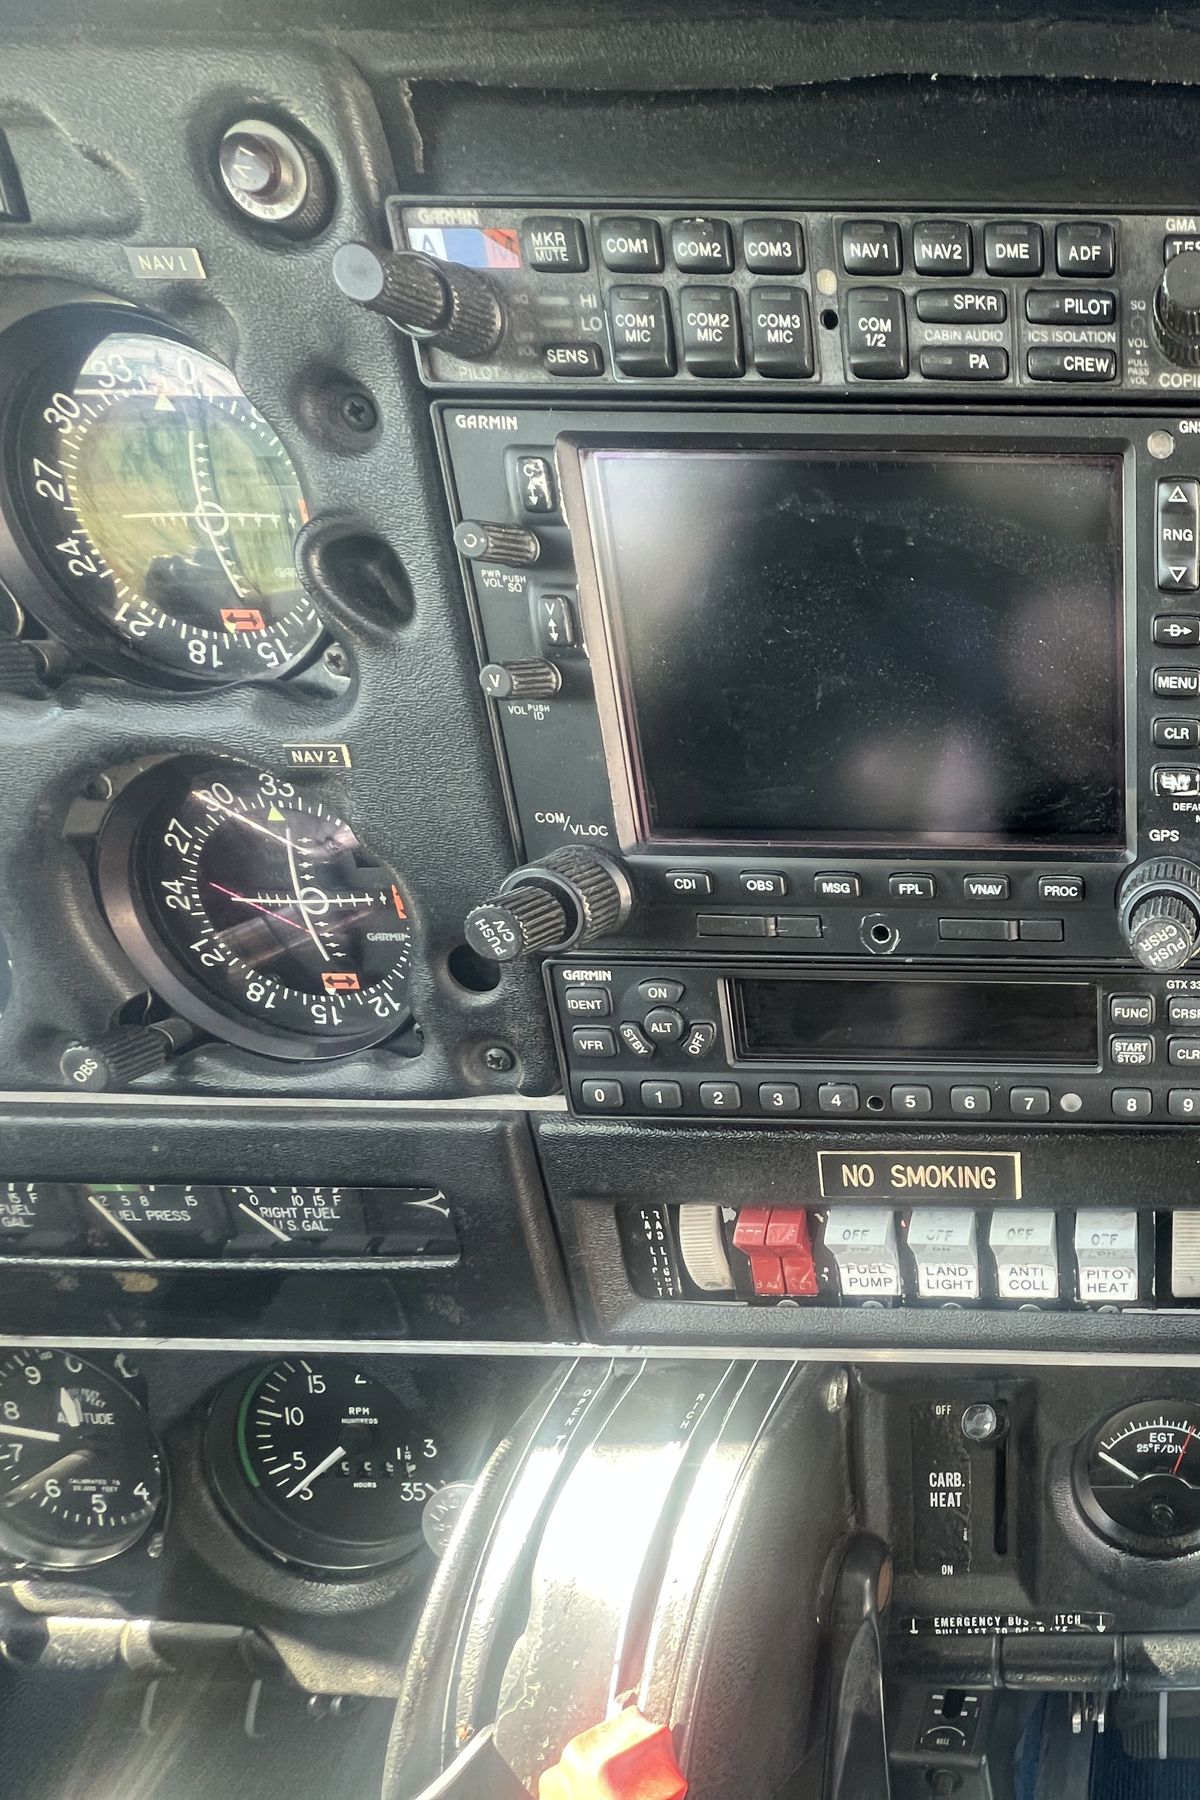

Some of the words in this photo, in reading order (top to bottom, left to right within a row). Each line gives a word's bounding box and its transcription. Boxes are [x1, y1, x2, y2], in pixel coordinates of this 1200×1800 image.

[531, 232, 566, 247] MKR
[606, 239, 648, 254] COM1
[678, 242, 721, 257] COM2
[748, 242, 791, 257] COM3
[850, 244, 888, 258] NAV1
[922, 245, 962, 259] NAV2
[996, 244, 1029, 258] DME
[1069, 246, 1101, 261] ADF
[954, 296, 997, 311] SPKR
[1065, 299, 1110, 315] PILOT
[615, 314, 655, 328] COM1
[687, 314, 729, 328] COM2
[758, 314, 800, 328] COM3
[859, 318, 891, 332] COM
[625, 330, 650, 343] MIC
[697, 329, 723, 342] MIC
[767, 330, 793, 343] MIC
[865, 333, 886, 347] 1/2
[925, 329, 966, 342] CABIN
[969, 329, 1003, 342] AUDIO
[547, 350, 588, 363] SENS
[969, 355, 988, 369] PA
[1064, 357, 1109, 371] CREW
[44, 392, 80, 434] 30
[455, 415, 517, 430] GARMIN
[35, 458, 63, 501] 27
[1163, 529, 1193, 541] RNG
[56, 539, 96, 577] 24
[483, 578, 503, 589] VOL
[508, 582, 522, 593] SQ
[115, 606, 154, 637] 21
[1158, 676, 1197, 688] MENU
[508, 705, 527, 715] VOL
[528, 704, 550, 713] PUSH
[1164, 728, 1189, 739] CLR
[164, 818, 192, 854] 27
[1150, 830, 1180, 841] GPS
[747, 880, 773, 891] OBS
[822, 882, 850, 894] MSG
[899, 884, 923, 895] FPL
[970, 884, 1001, 895] VNAV
[1044, 885, 1078, 897] PROC
[162, 879, 190, 910] 24
[475, 917, 506, 955] PUSH
[1139, 924, 1177, 952] CRSR
[190, 938, 225, 967] 21
[563, 970, 611, 981] GARMIN
[246, 982, 275, 1008] 18
[648, 988, 667, 998] ON
[568, 1000, 602, 1009] IDENT
[1115, 1008, 1148, 1018] FUNC
[624, 1028, 648, 1056] STBY
[688, 1032, 705, 1054] OFF
[1115, 1043, 1147, 1052] START
[1117, 1054, 1145, 1063] STOP
[1177, 1050, 1200, 1059] CLR
[73, 1058, 98, 1083] OBS
[841, 1164, 874, 1187] NO
[891, 1165, 997, 1189] SMOKING
[122, 1196, 130, 1206] 5
[186, 1196, 197, 1206] 15
[292, 1196, 303, 1206] 10
[313, 1196, 325, 1206] 15
[334, 1196, 340, 1206] F
[260, 1207, 297, 1218] RIGHT
[304, 1208, 340, 1218] FUEL
[926, 1267, 968, 1276] LAND
[1009, 1268, 1043, 1276] ANTI
[849, 1277, 892, 1287] PUMP
[927, 1279, 973, 1289] LIGHT
[1010, 1280, 1049, 1290] COLL
[25, 1367, 41, 1385] 9
[307, 1376, 325, 1393] 15
[284, 1408, 304, 1424] 10
[1150, 1433, 1174, 1443] EGT
[929, 1473, 965, 1487] CARB.
[45, 1478, 61, 1498] 6
[400, 1484, 426, 1500] 35
[92, 1494, 107, 1513] 5
[930, 1493, 962, 1507] HEAT
